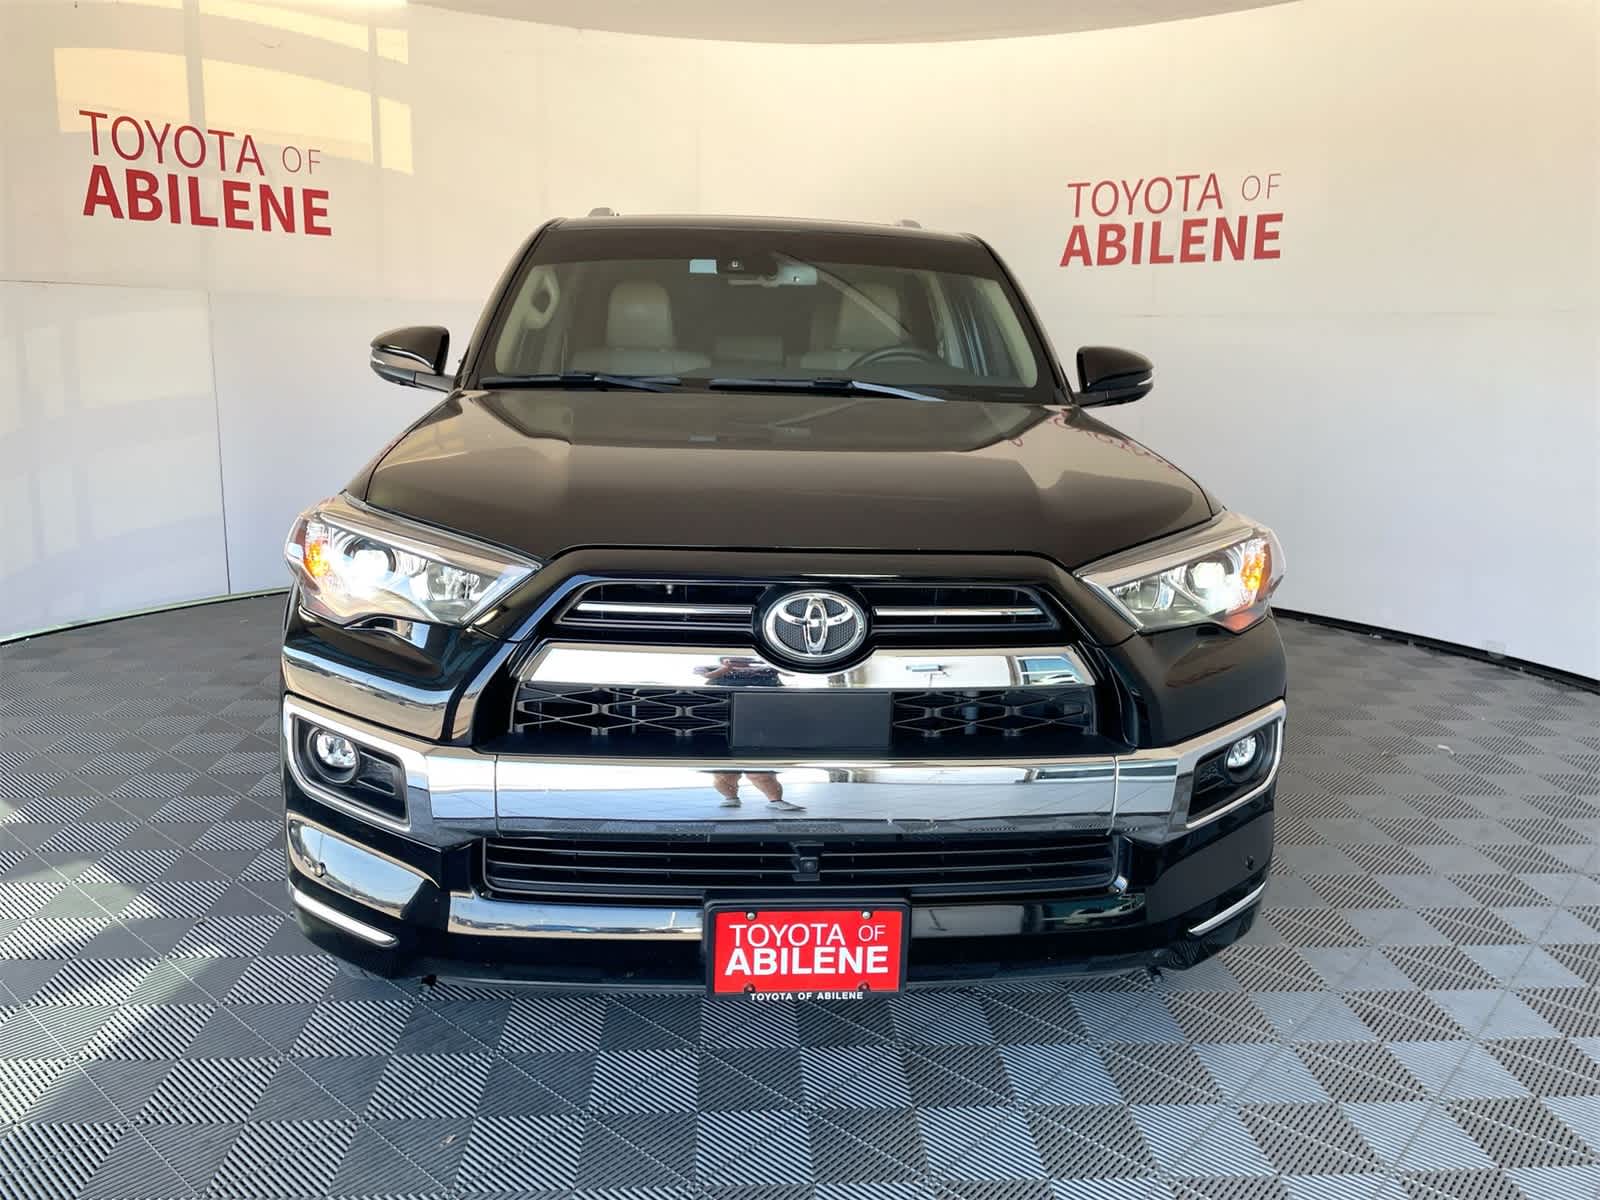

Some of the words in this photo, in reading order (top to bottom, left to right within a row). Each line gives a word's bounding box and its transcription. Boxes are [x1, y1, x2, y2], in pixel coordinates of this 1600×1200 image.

[79, 109, 265, 176] TOYOTA
[281, 145, 321, 174] OF
[83, 163, 332, 236] ABILENE
[1067, 172, 1223, 218] TOYOTA
[1241, 173, 1281, 201] OF
[1059, 213, 1284, 267] ABILENE
[729, 923, 846, 947] TOYOTA
[858, 924, 886, 942] OF
[724, 946, 889, 976] ABILENE
[750, 992, 793, 1001] TOYOTA
[797, 992, 813, 1000] OF
[816, 991, 864, 1000] ABILENE
